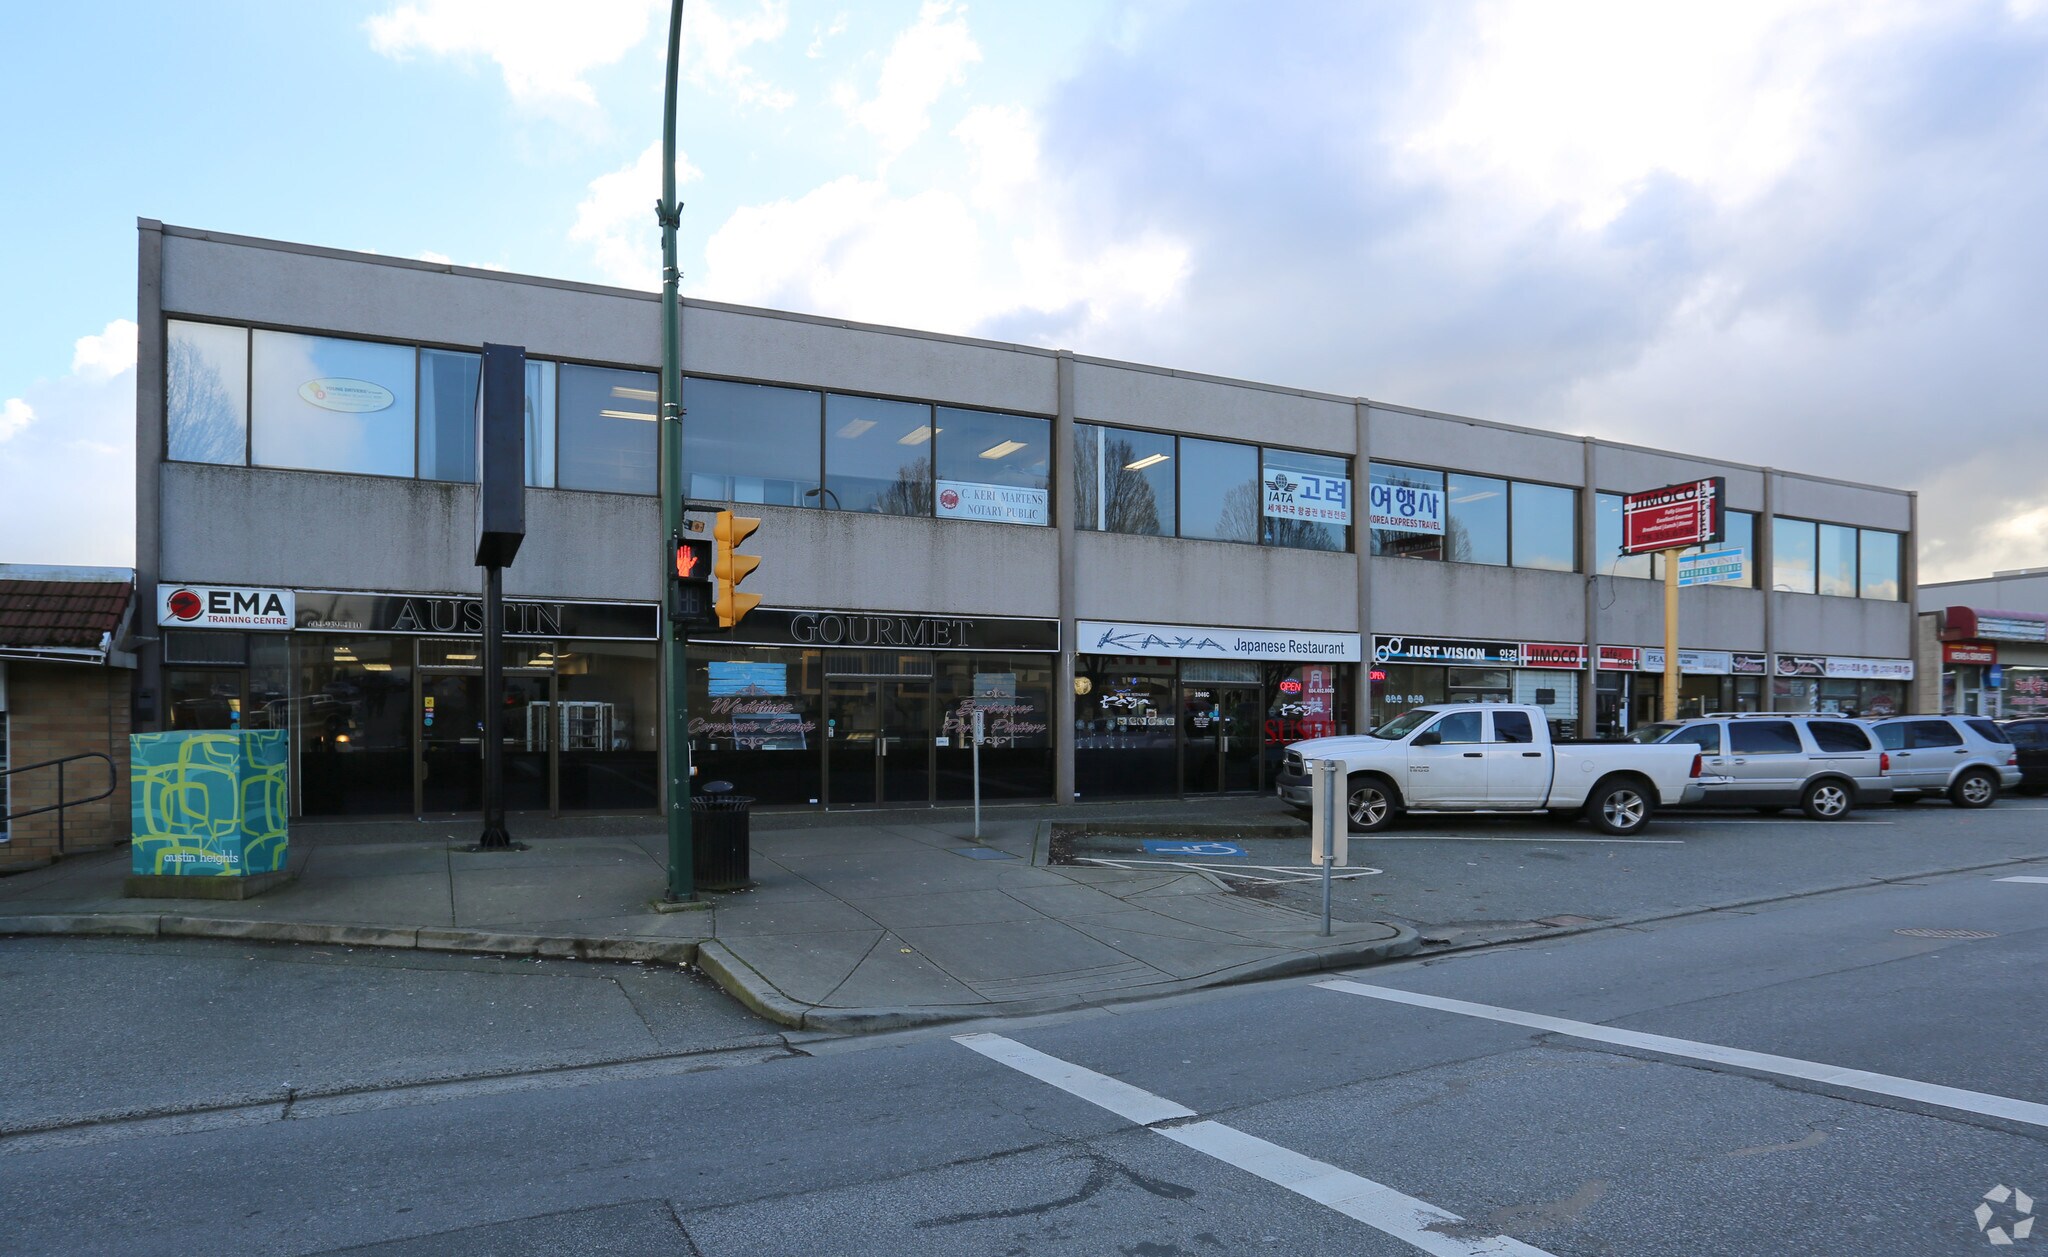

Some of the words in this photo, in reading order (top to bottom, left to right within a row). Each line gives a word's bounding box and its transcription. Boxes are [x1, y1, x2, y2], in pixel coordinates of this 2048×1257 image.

[962, 488, 970, 499] C.
[974, 490, 996, 501] KERI
[1002, 492, 1043, 505] MARTENS
[1268, 492, 1294, 503] IATA
[1300, 476, 1346, 509] 고려
[1370, 485, 1440, 519] 여행사
[968, 504, 1002, 517] NOTARY
[1006, 508, 1039, 520] PUBLIC
[1390, 516, 1418, 528] EXPRESS
[1419, 519, 1441, 530] TRAVEL
[208, 591, 286, 616] EMA
[208, 616, 250, 624] TRAINING
[254, 617, 288, 625] CENTRE
[790, 614, 974, 647] GOURMET
[1097, 628, 1228, 652] KAYA
[1234, 638, 1286, 654] Japanese
[1289, 640, 1345, 655] Restaurant
[1406, 644, 1440, 658] JUST
[1442, 646, 1486, 660] VISION
[1499, 648, 1518, 662] 안경
[1527, 648, 1578, 664] JIMOCO
[1370, 671, 1385, 680] OPEN
[1280, 682, 1302, 692] OPEN
[710, 698, 794, 715] Weddings
[1265, 719, 1336, 744] SUSHI
[164, 850, 196, 862] austin
[200, 850, 238, 864] heights
